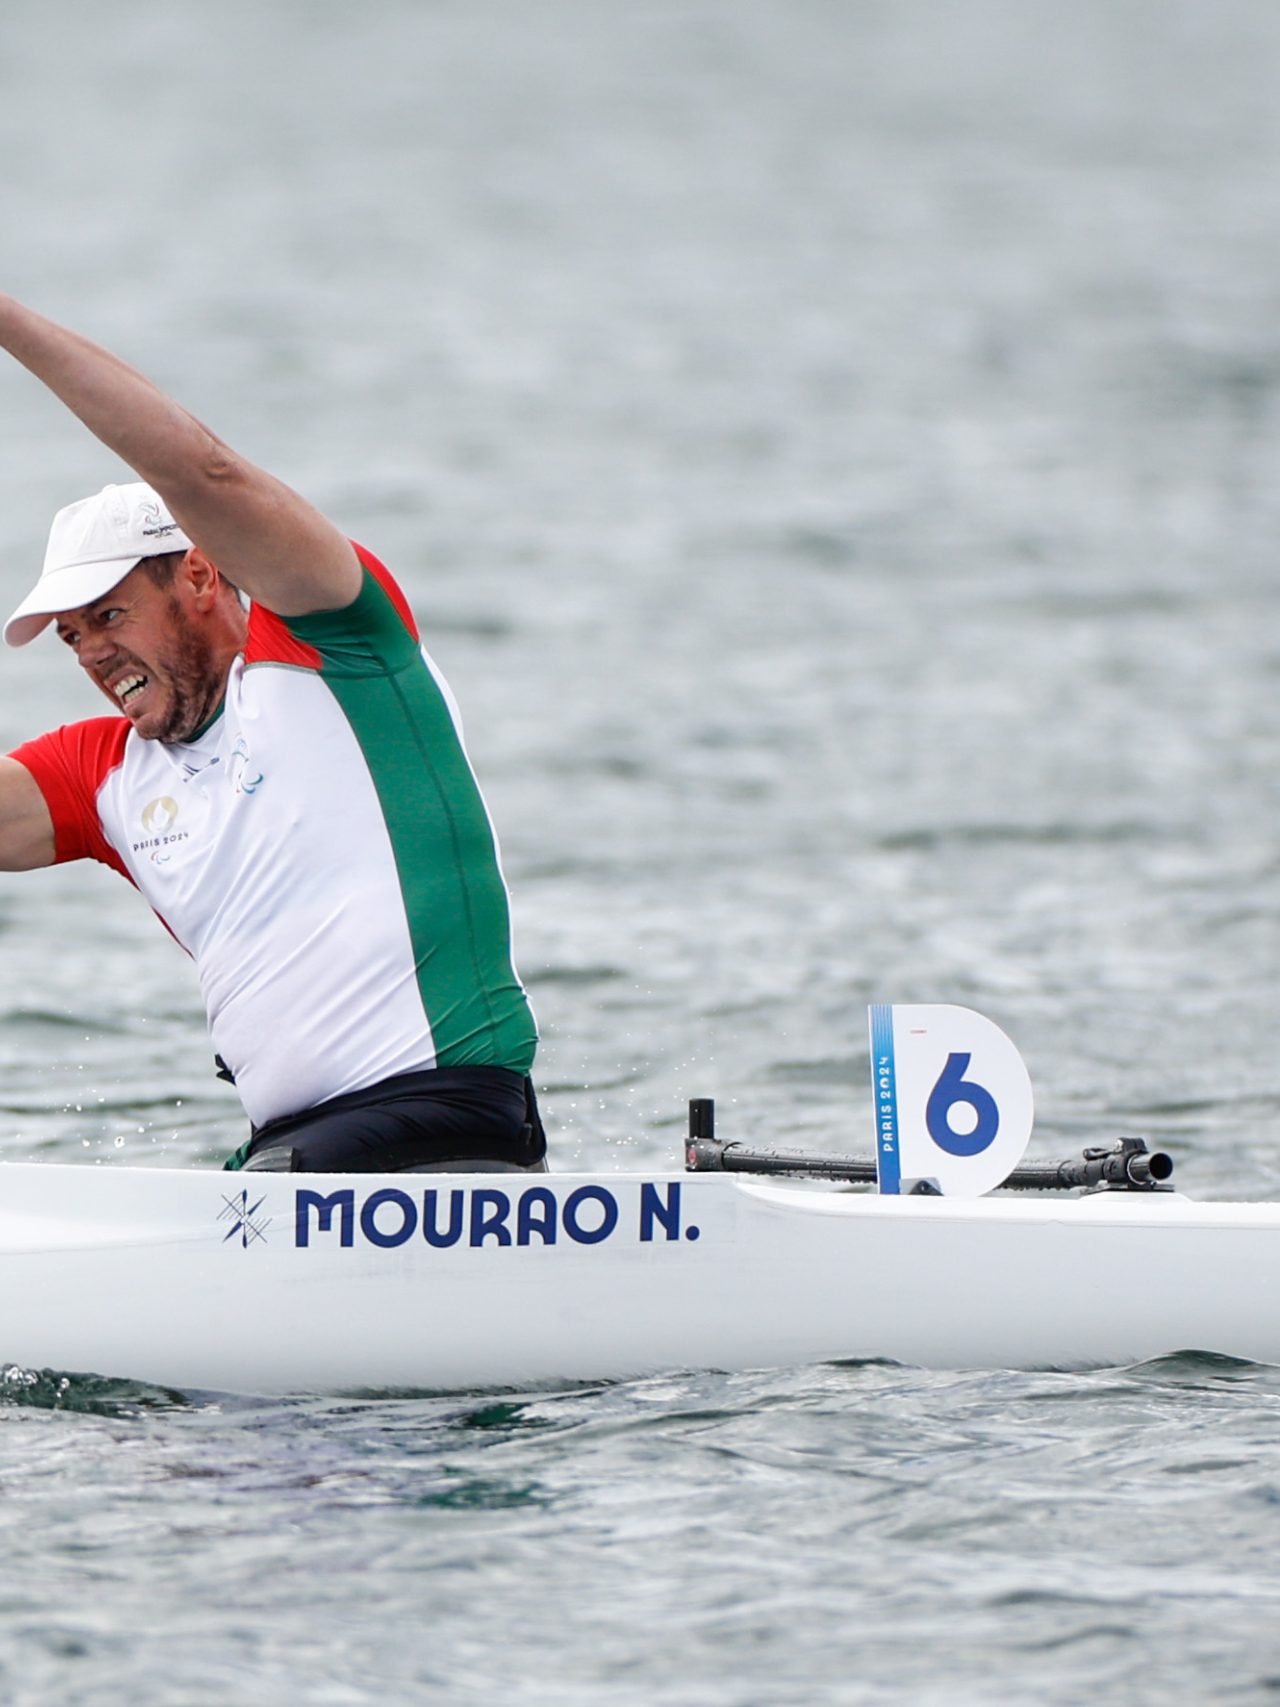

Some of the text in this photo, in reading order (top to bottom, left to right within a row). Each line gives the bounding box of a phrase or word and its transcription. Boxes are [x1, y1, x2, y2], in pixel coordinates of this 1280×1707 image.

[879, 1056, 894, 1152] PARIS 2024
[925, 1052, 1000, 1157] 6
[295, 1182, 700, 1248] MOURAO N.
